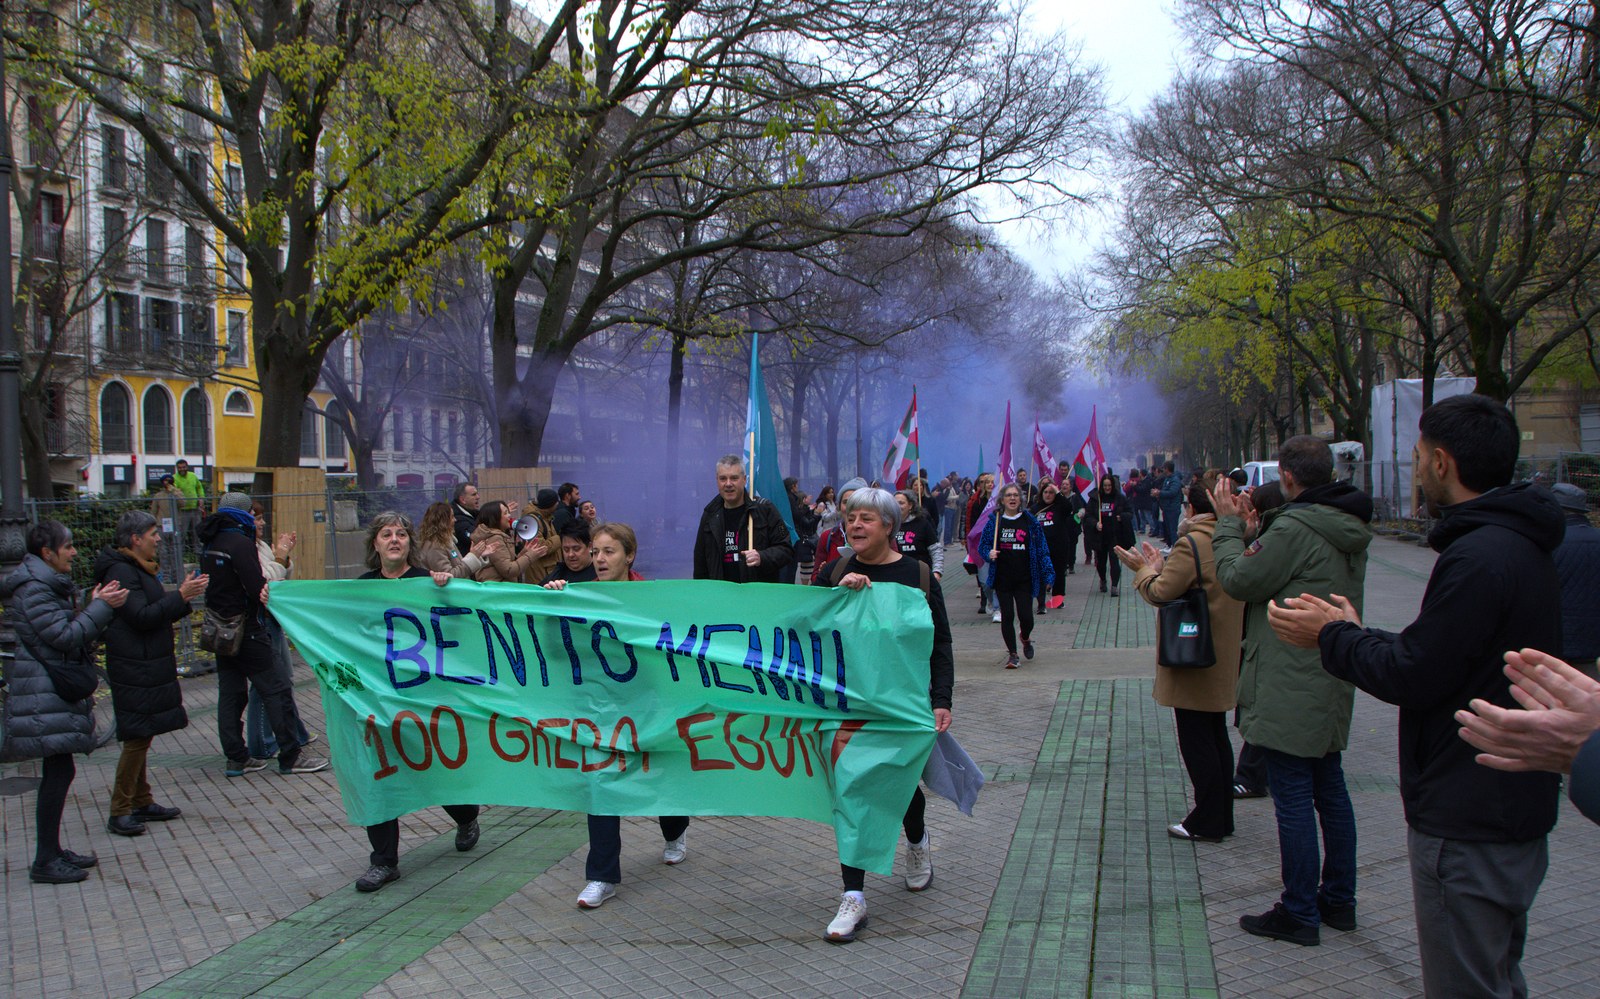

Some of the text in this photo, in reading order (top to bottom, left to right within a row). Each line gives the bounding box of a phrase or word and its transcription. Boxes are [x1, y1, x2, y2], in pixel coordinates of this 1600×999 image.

[384, 606, 851, 713] BENITO MENNI
[364, 704, 468, 781] 100
